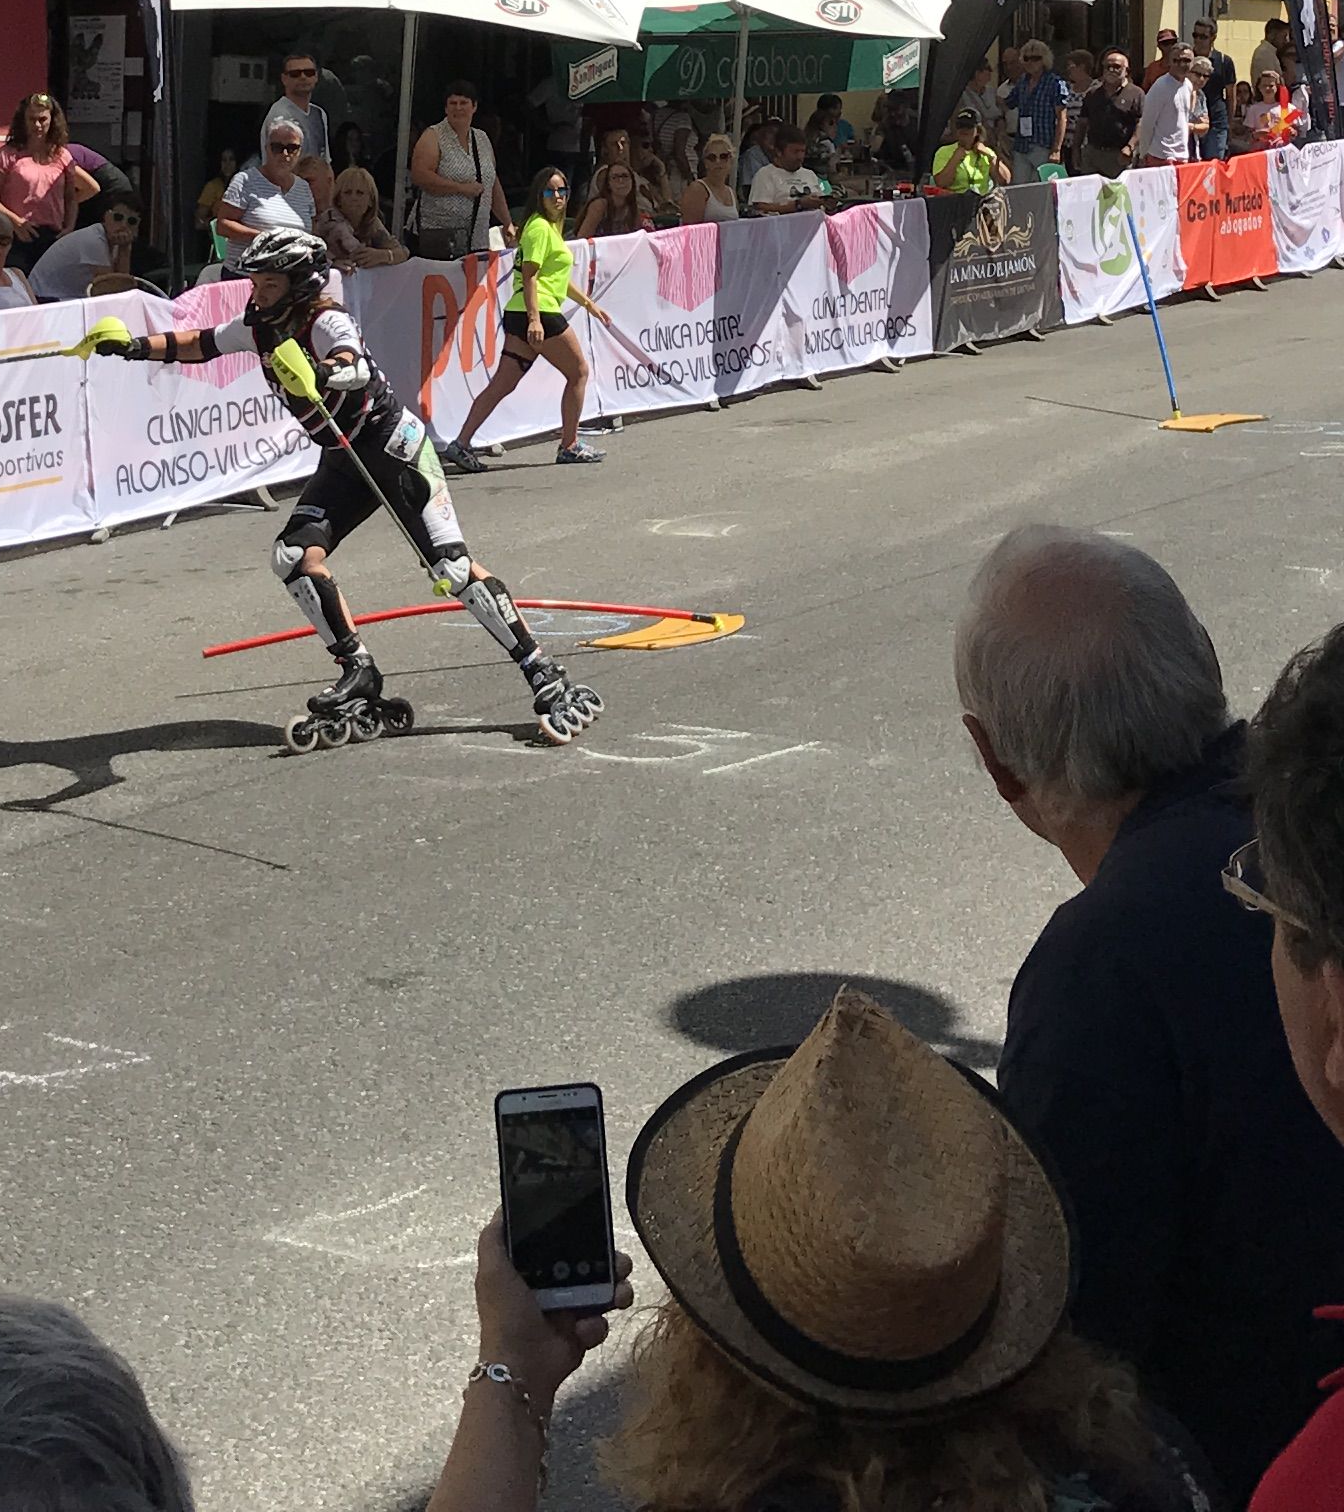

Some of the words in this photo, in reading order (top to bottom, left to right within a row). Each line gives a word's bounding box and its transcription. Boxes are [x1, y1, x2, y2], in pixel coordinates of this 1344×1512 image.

[716, 45, 833, 87] ctabaar
[638, 321, 692, 353] CLÍNICA
[695, 313, 745, 345] DENTAL
[147, 402, 223, 447] CLÍNICA
[226, 391, 293, 435] DENT
